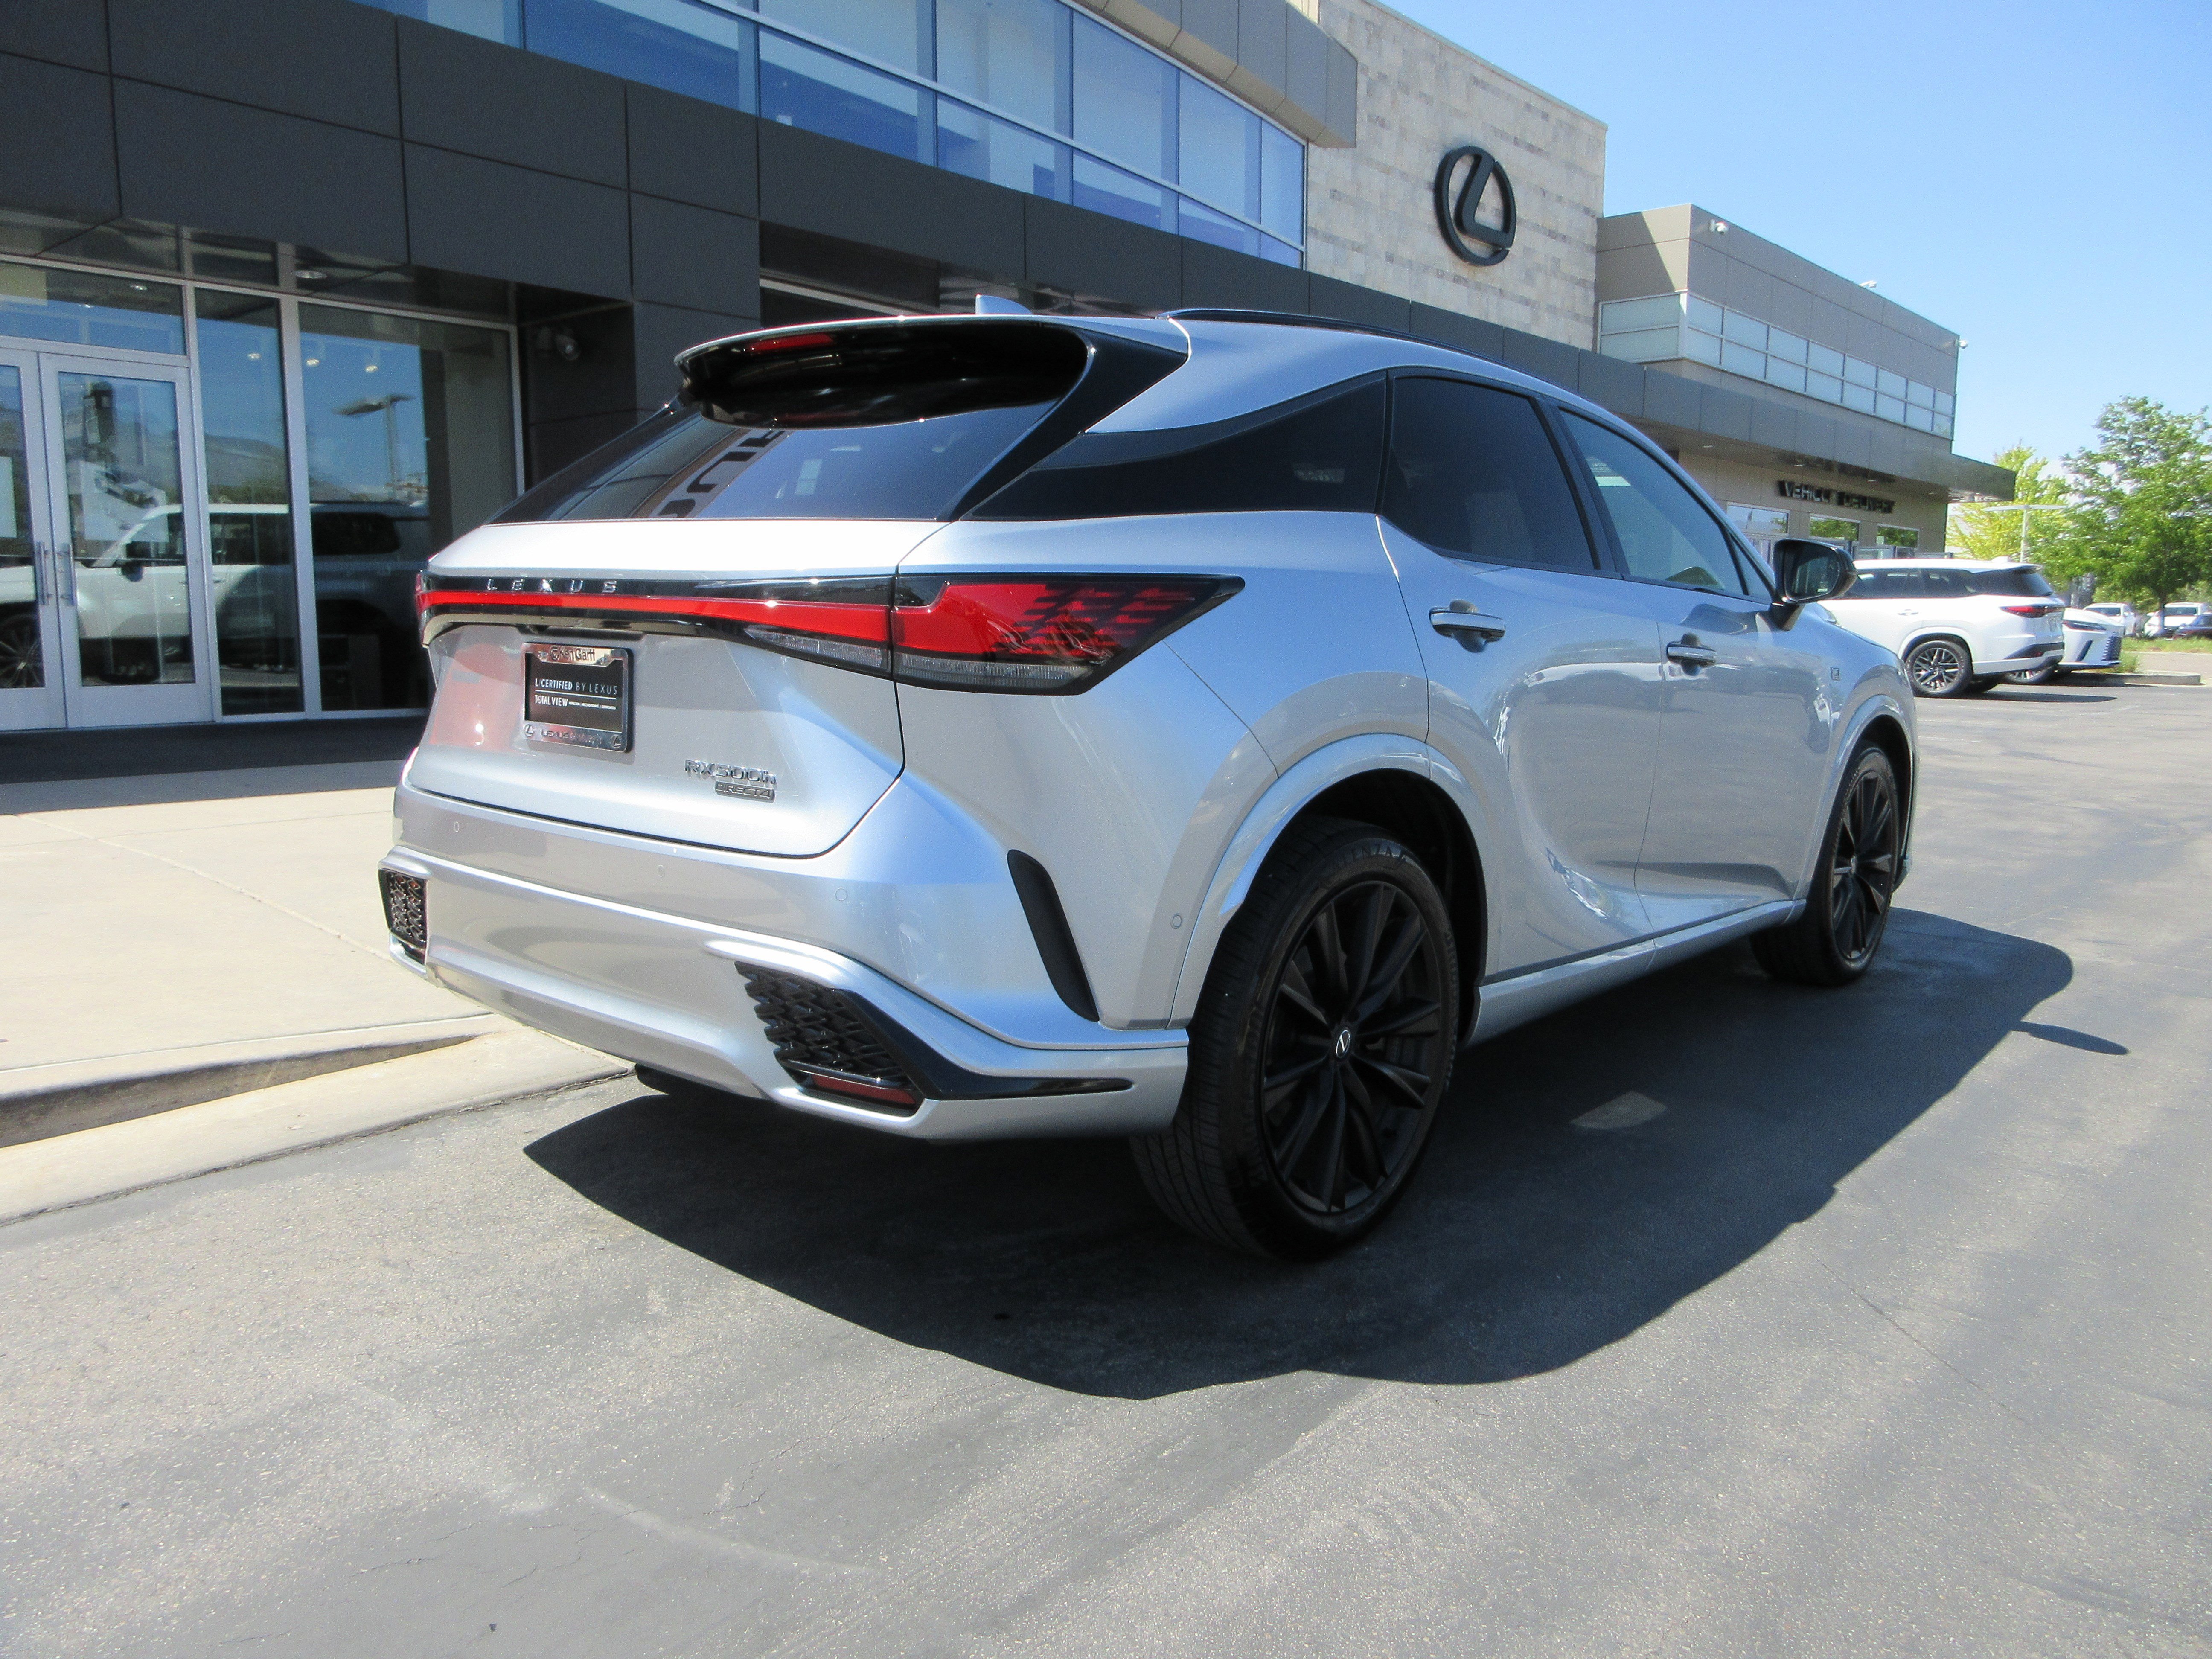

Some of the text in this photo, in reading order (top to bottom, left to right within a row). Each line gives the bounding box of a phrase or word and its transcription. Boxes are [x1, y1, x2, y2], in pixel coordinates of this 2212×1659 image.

[486, 578, 617, 593] LEXUS
[576, 648, 595, 661] Garff
[576, 682, 586, 691] BY
[589, 683, 617, 695] LEXUS
[534, 694, 550, 706] TOTAL
[551, 696, 568, 707] VIEW
[541, 728, 569, 739] LEXUS
[715, 784, 771, 799] DIRECT4
